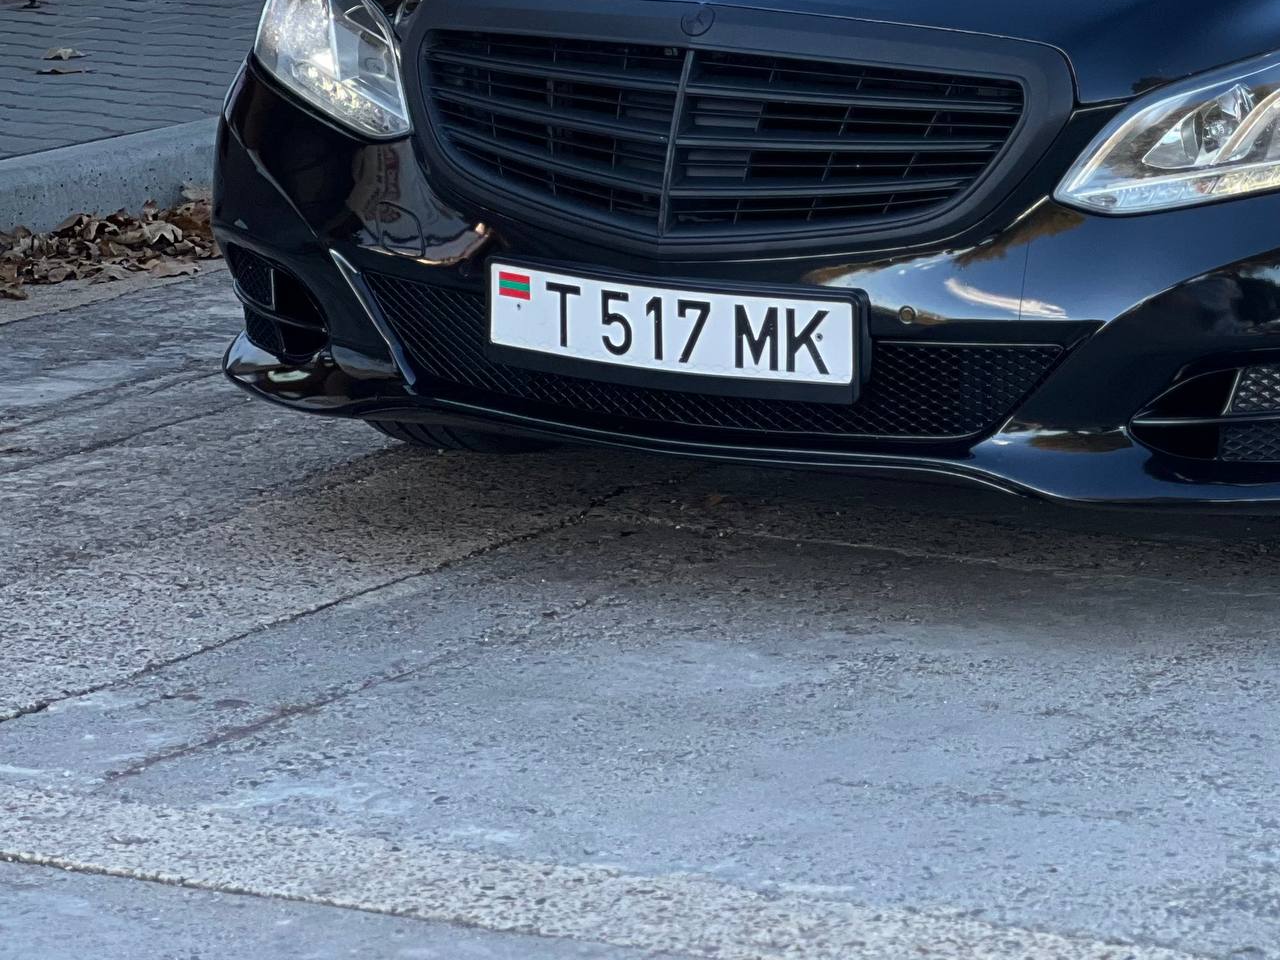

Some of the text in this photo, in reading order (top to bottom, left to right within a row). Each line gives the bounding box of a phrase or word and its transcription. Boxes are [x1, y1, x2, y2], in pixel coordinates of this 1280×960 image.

[546, 281, 830, 375] T 517 MK
